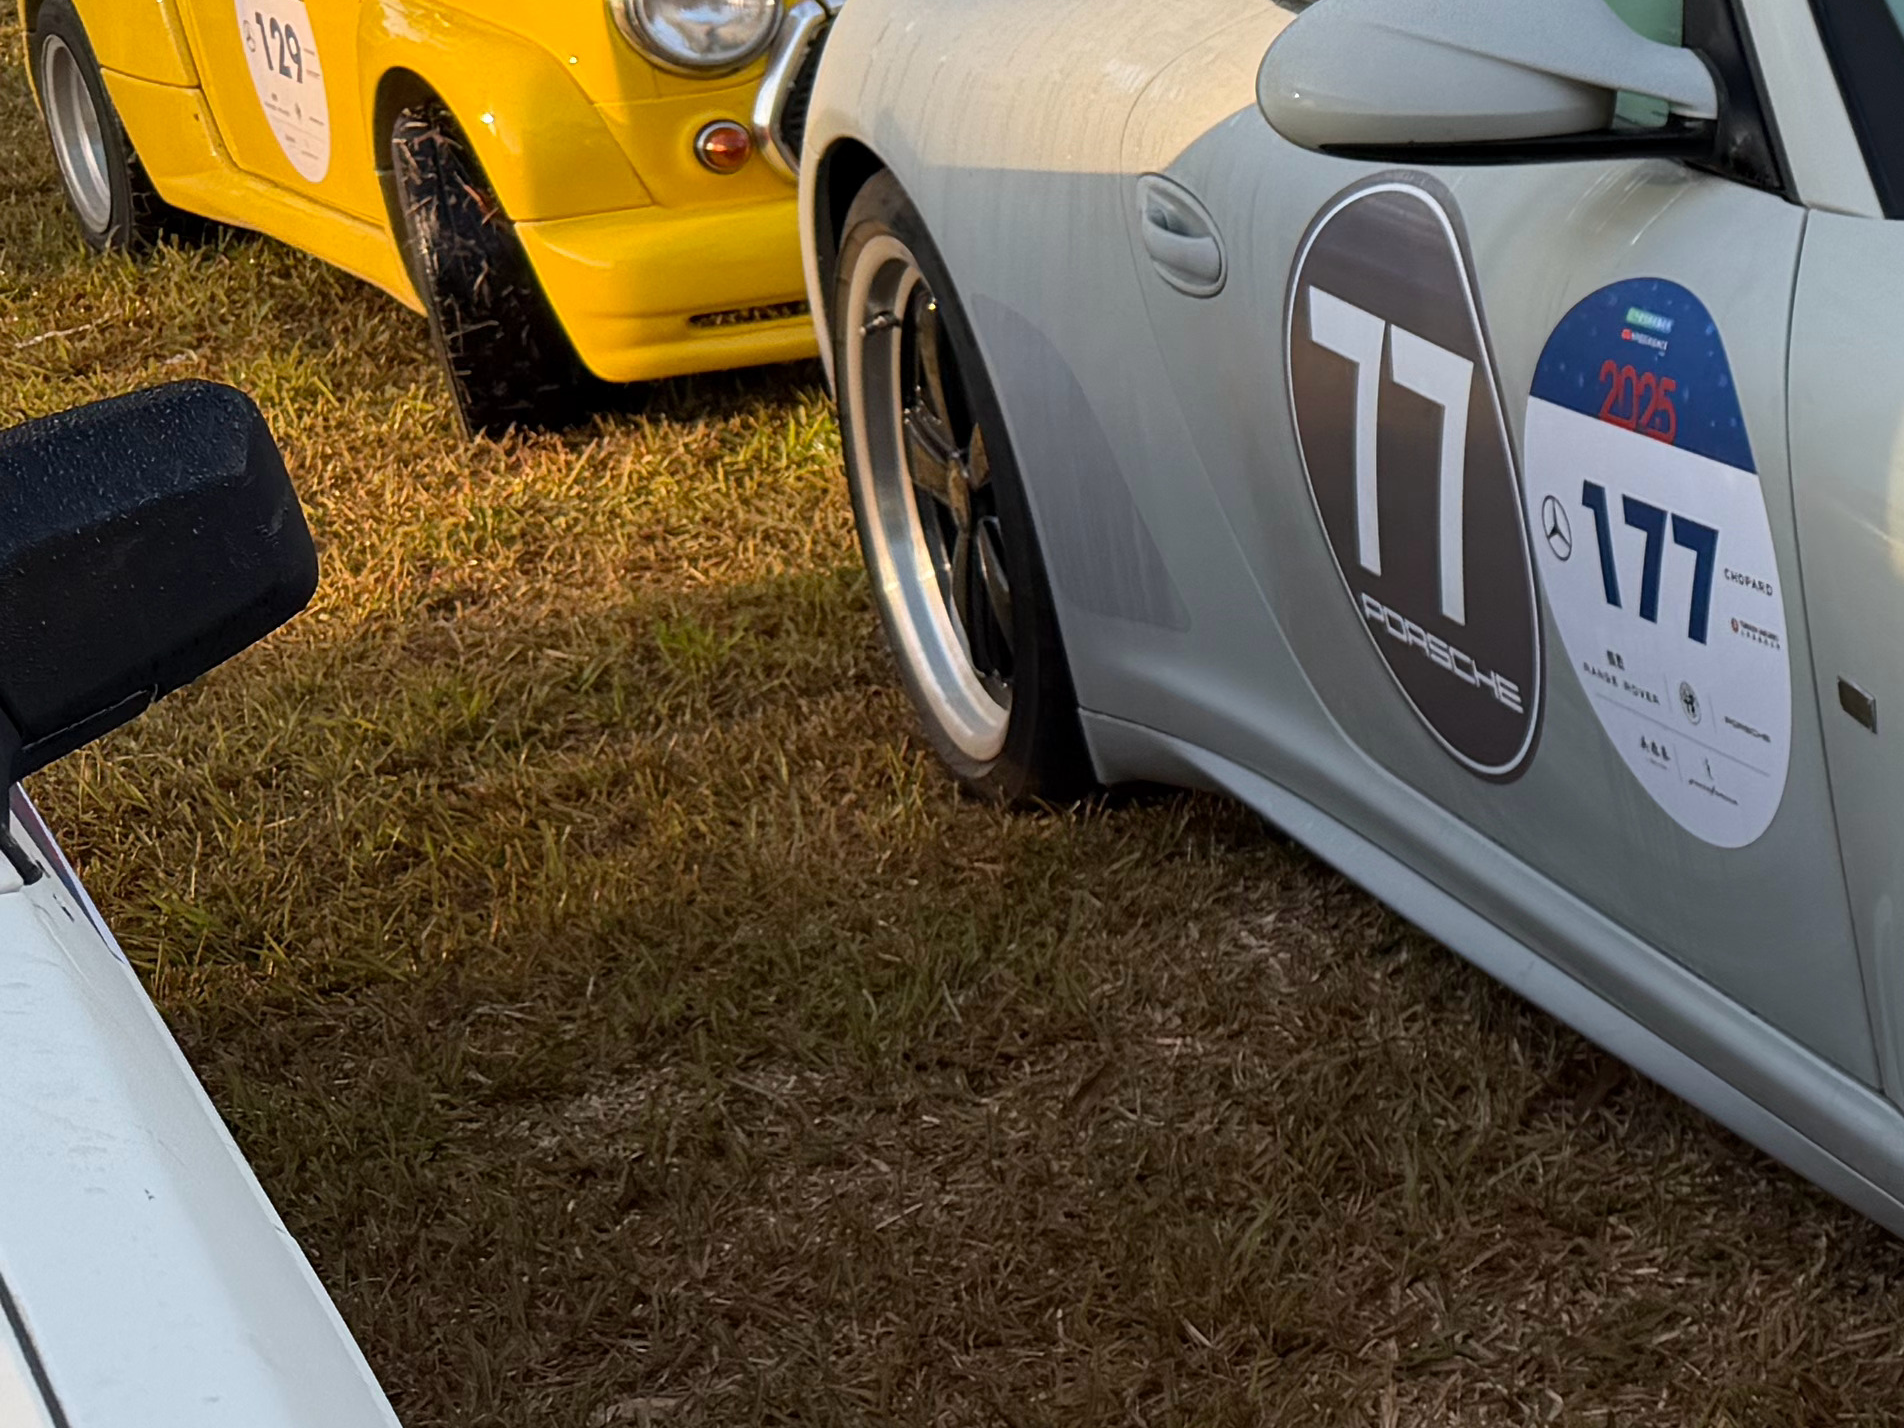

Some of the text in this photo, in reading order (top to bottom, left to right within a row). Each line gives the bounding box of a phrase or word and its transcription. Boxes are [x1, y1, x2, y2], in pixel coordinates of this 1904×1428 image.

[254, 12, 303, 84] 129
[1597, 359, 1677, 445] 2025
[1309, 285, 1474, 627] 77
[1582, 479, 1719, 646] 177
[1724, 568, 1773, 596] CHOPARD
[1361, 592, 1524, 714] PORSCHE
